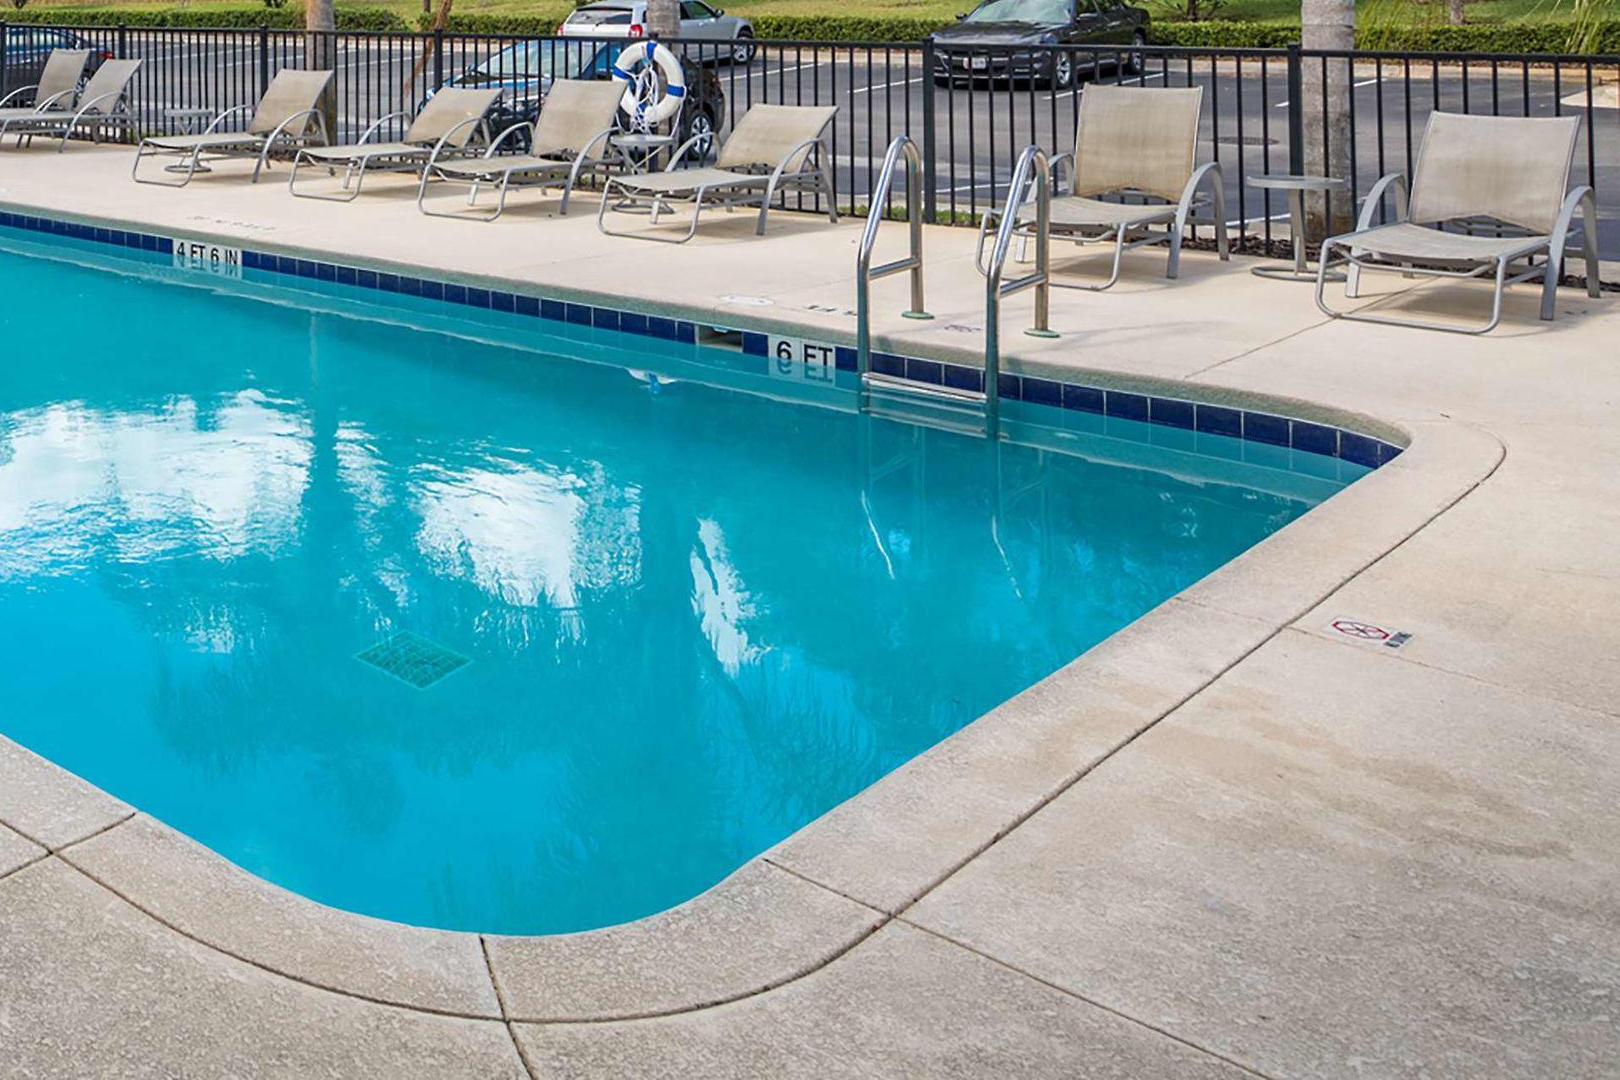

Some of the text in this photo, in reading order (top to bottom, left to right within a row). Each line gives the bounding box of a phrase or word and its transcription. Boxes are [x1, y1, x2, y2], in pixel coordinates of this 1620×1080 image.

[177, 242, 238, 265] 4 FT 6 IN
[777, 341, 832, 365] 6 FT
